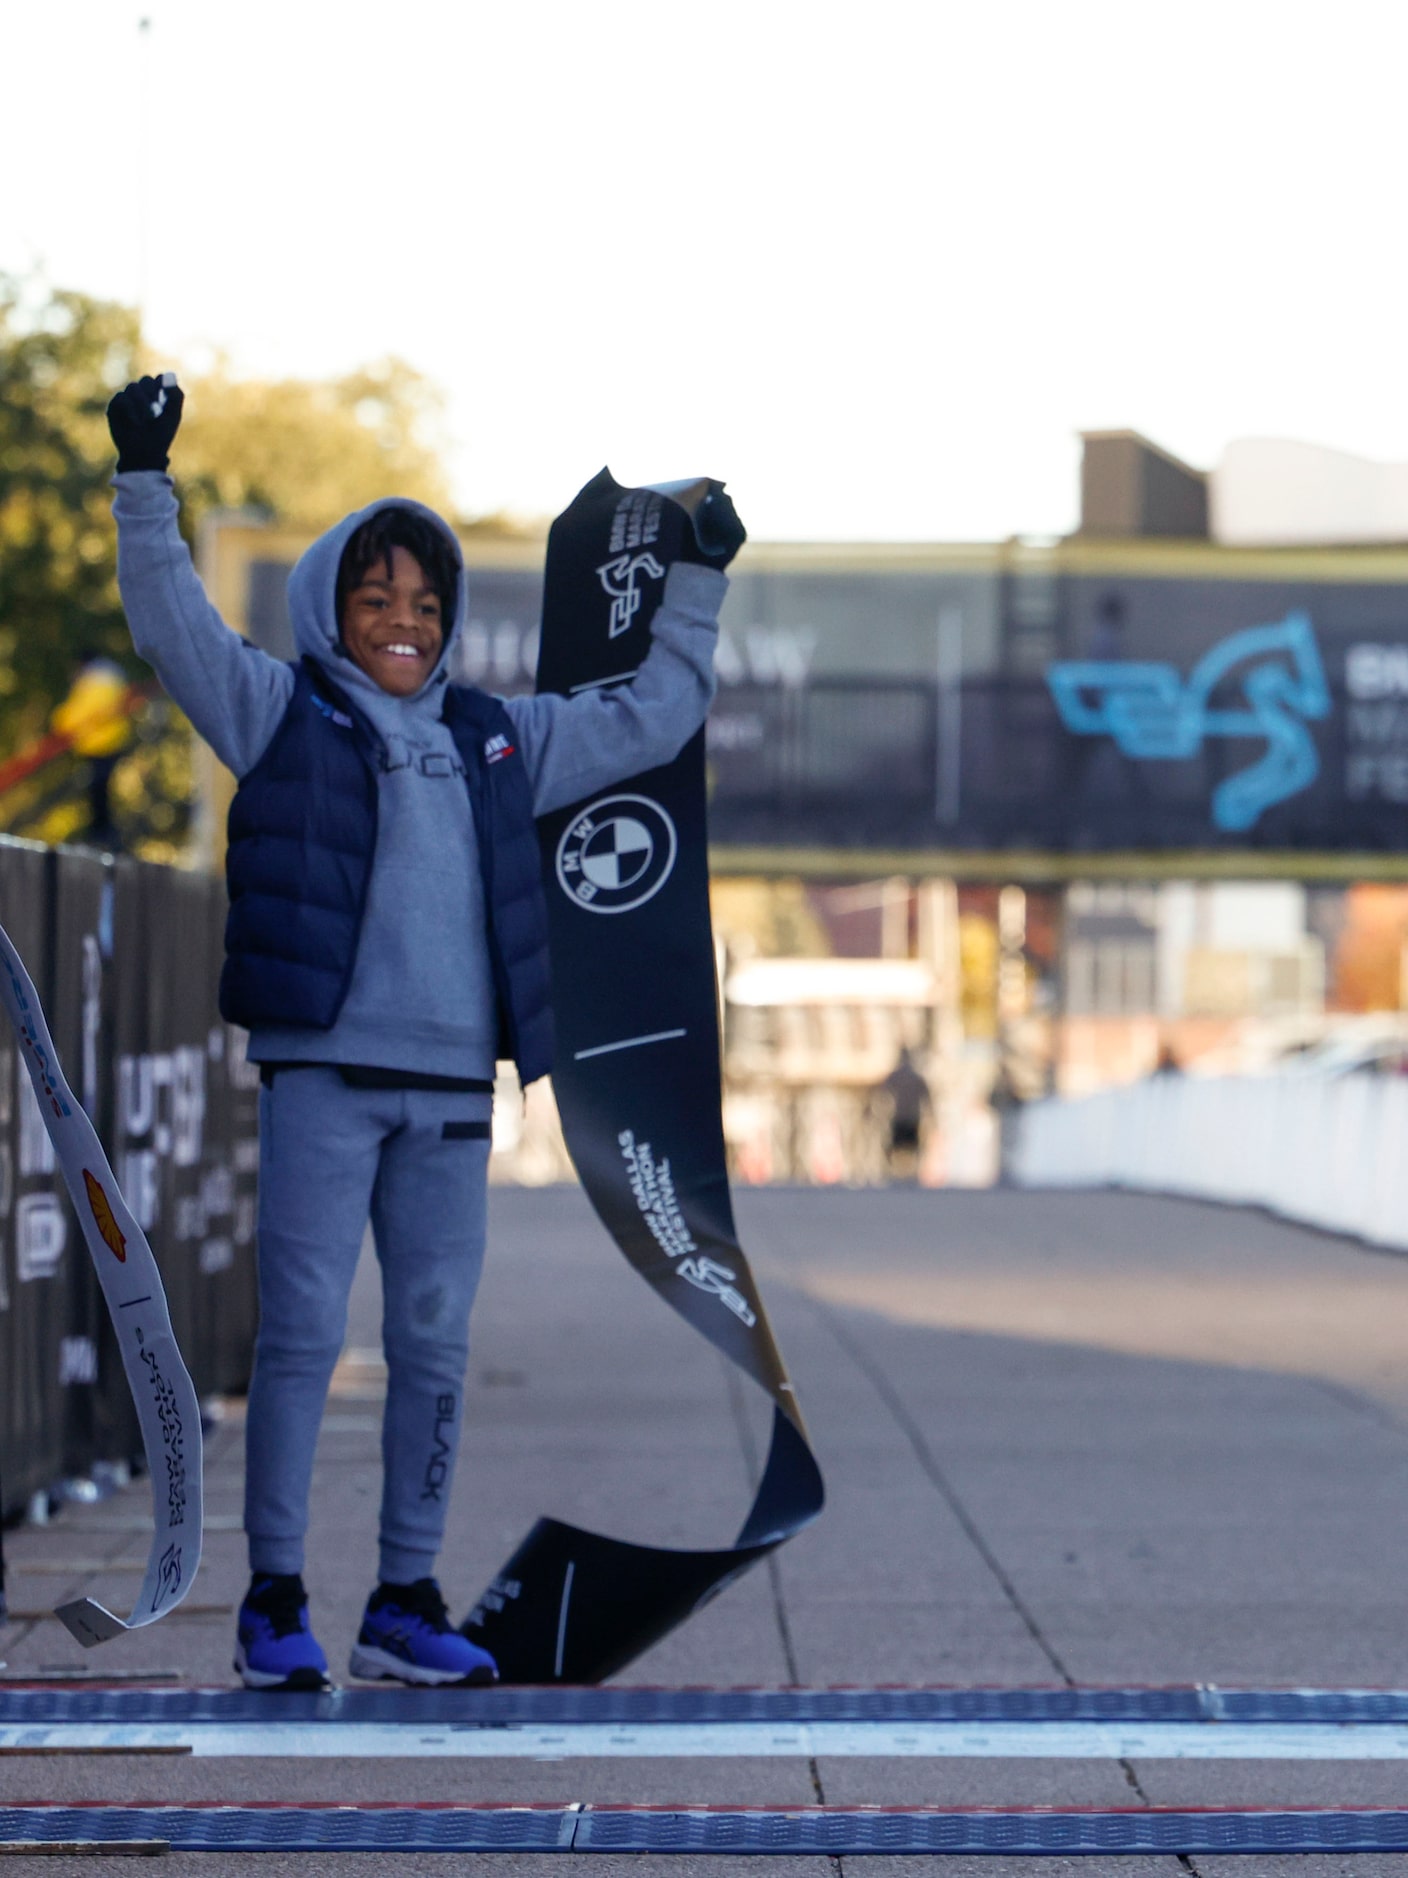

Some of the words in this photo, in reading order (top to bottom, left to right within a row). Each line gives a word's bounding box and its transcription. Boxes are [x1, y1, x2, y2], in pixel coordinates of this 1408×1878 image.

[380, 749, 466, 779] LACK
[618, 1129, 651, 1212] DALLAS
[636, 1142, 687, 1255] MARATHON
[656, 1157, 698, 1252] FESTIVAL
[644, 1212, 679, 1258] BMW
[135, 1326, 170, 1444] DALLAS
[147, 1350, 181, 1525] MARATHON
[420, 1393, 456, 1501] BLACK
[165, 1454, 178, 1527] BMW
